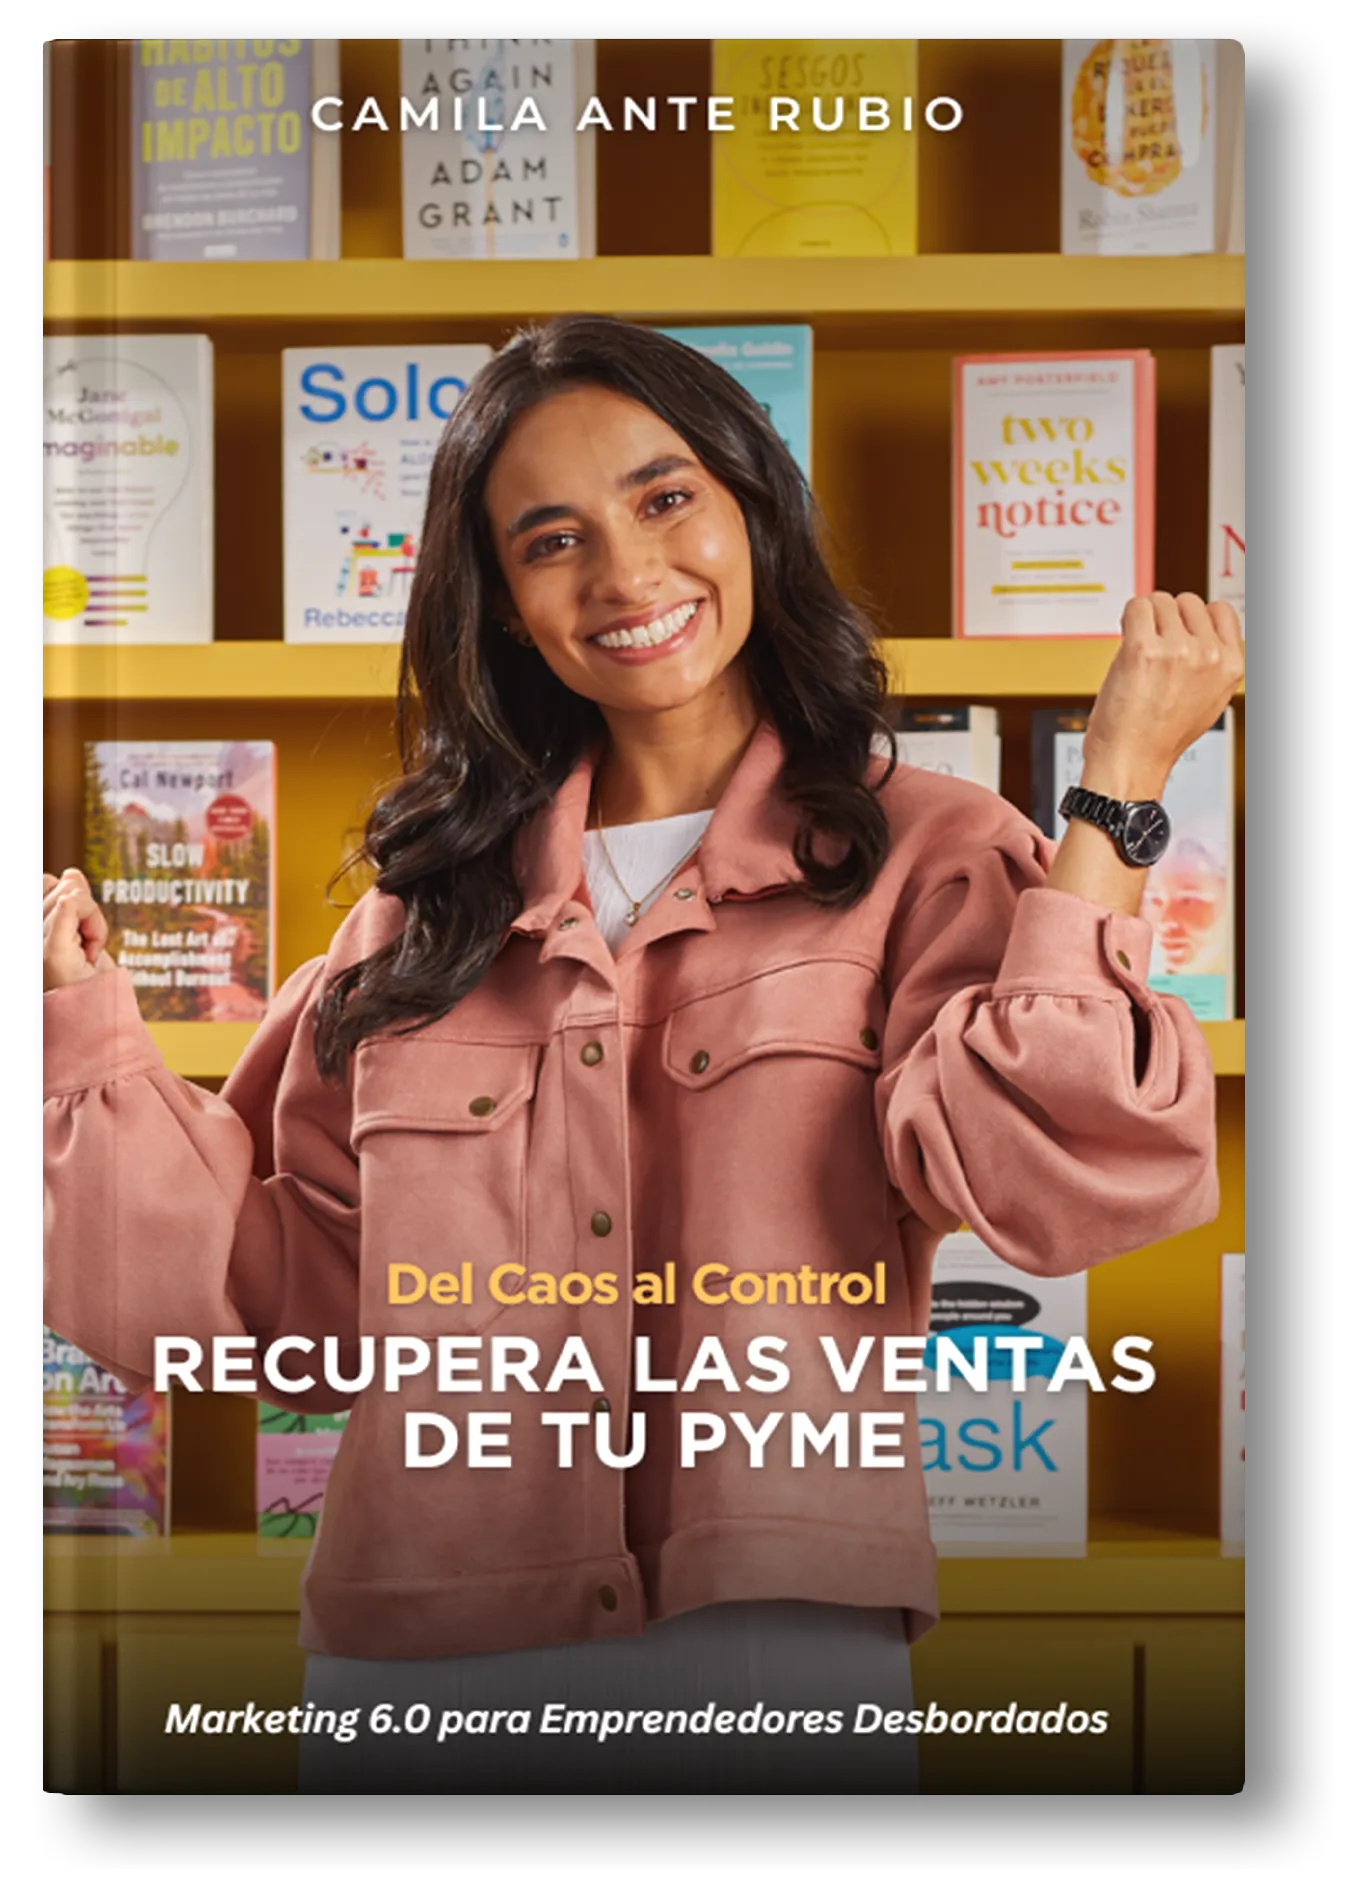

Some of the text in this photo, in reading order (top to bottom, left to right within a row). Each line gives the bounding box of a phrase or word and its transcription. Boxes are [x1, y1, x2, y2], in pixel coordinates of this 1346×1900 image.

[155, 60, 285, 114] DE ALTO
[421, 63, 553, 95] AGAIN
[759, 52, 866, 91] SESGOS
[141, 110, 301, 163] IMPACTO
[431, 156, 548, 187] ADAM
[418, 195, 563, 229] GRANT
[299, 362, 469, 424] Solo
[1000, 411, 1094, 446] two
[969, 448, 1127, 487] weeks
[976, 489, 1122, 538] notice
[119, 768, 235, 792] Cal Newport
[146, 841, 206, 869] SLOW
[102, 878, 250, 906] PRODUCTIVITY
[919, 1400, 1058, 1472] ask
[928, 1495, 955, 1508] EFF
